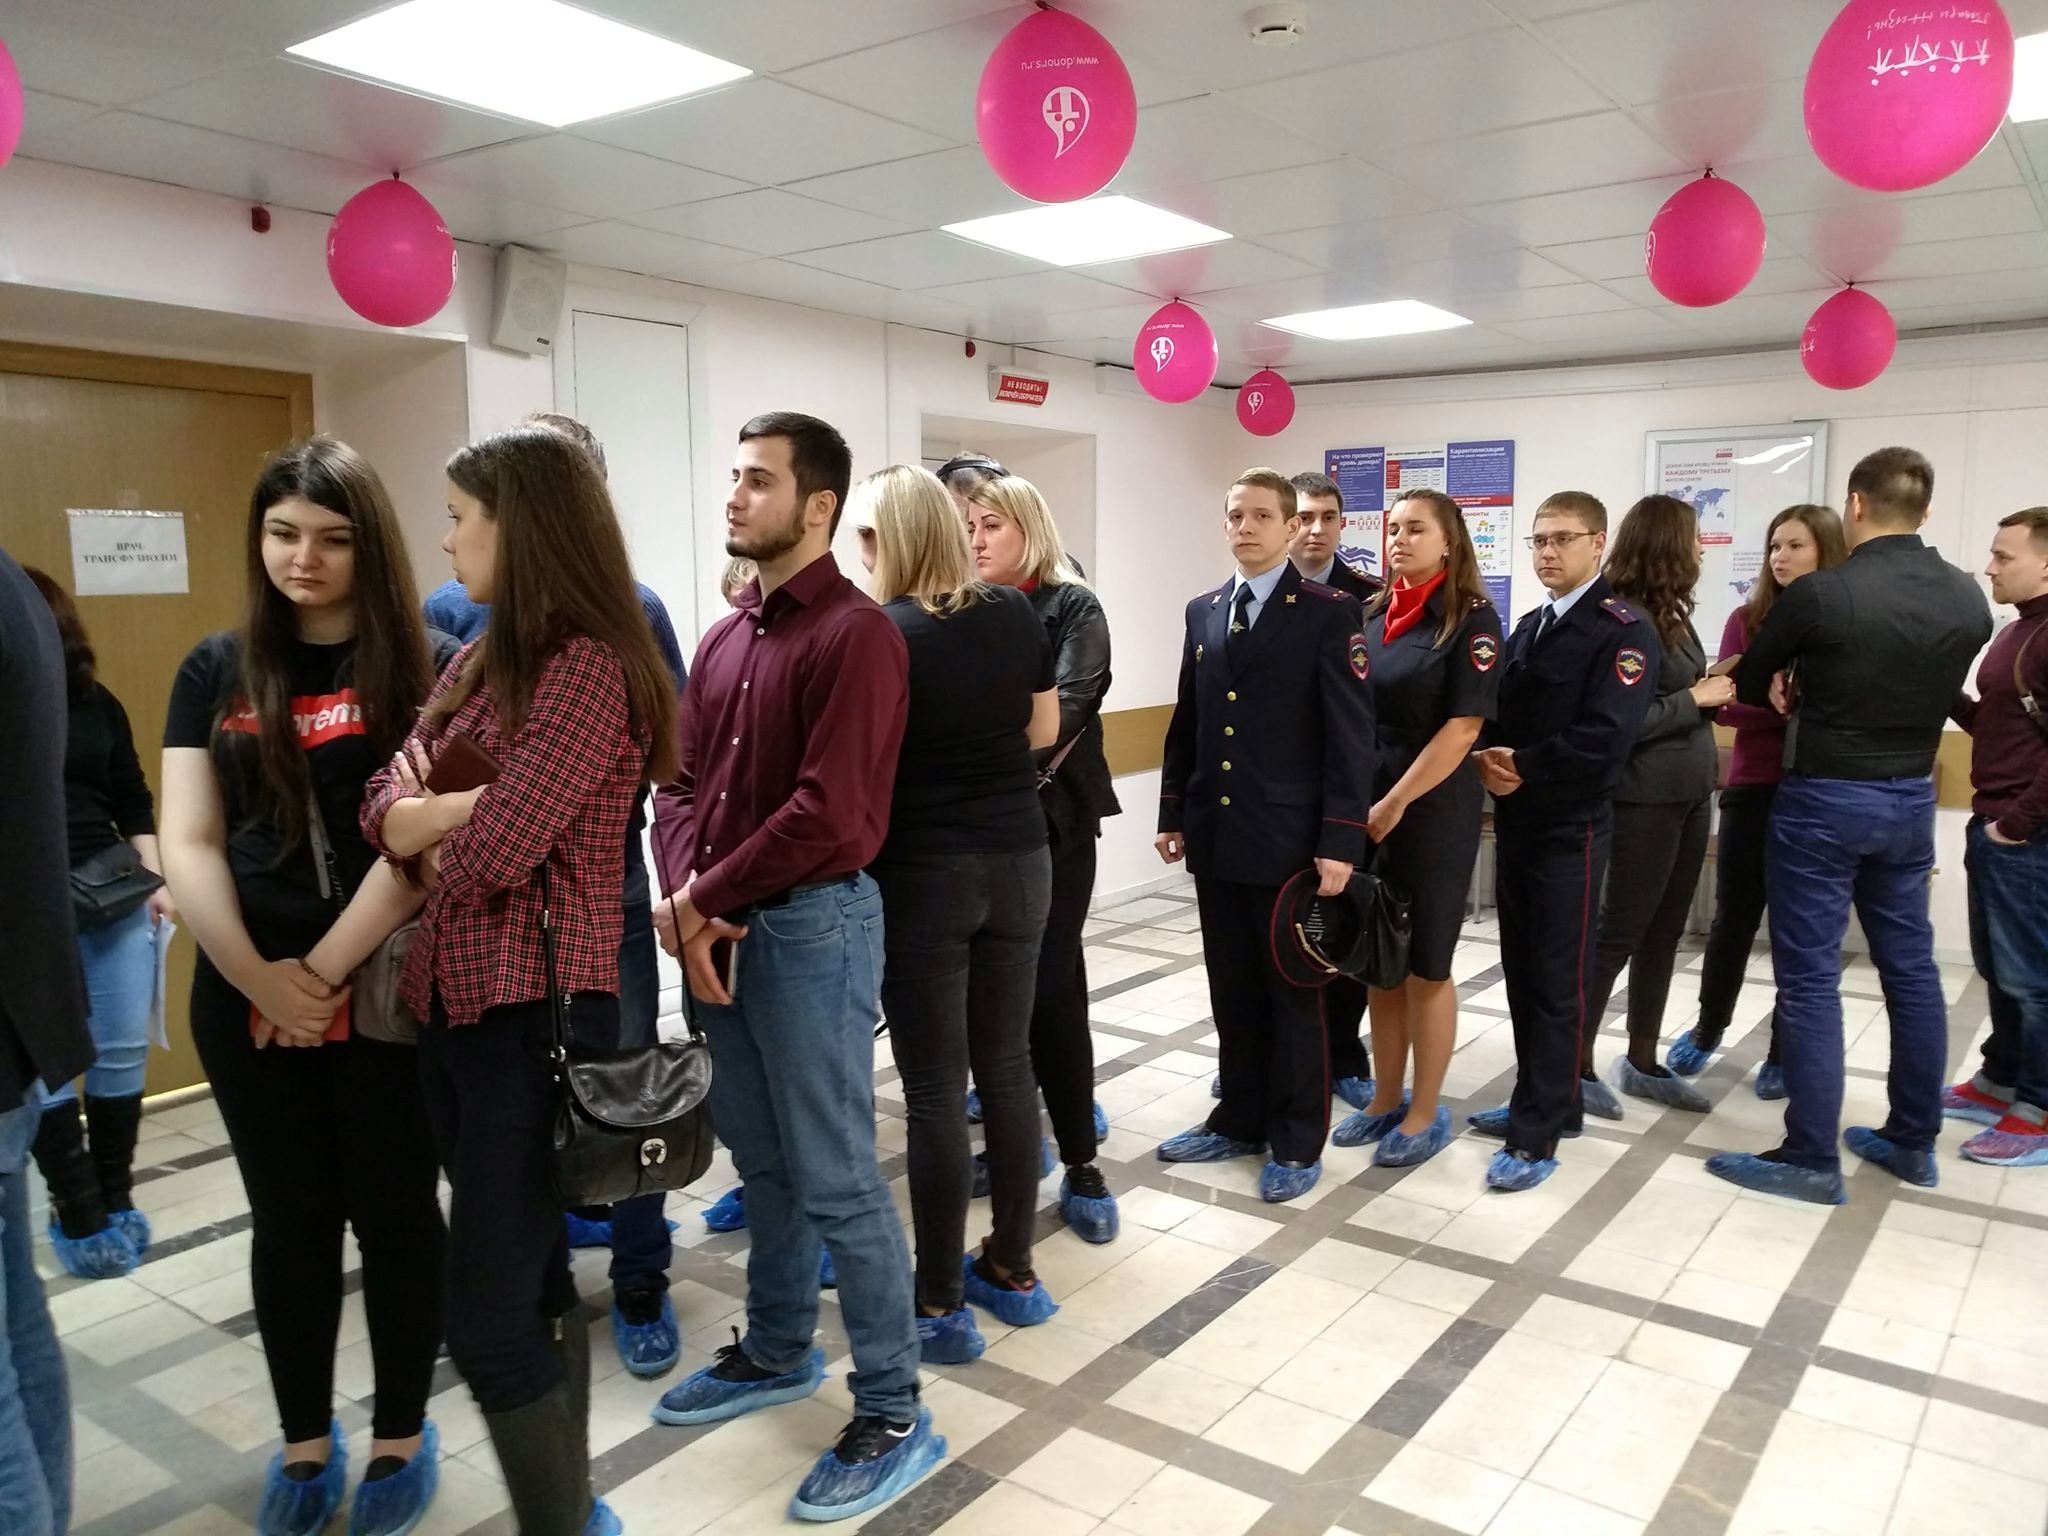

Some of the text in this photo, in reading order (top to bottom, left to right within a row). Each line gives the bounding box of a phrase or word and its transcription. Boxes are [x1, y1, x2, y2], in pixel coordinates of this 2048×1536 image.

[1021, 56, 1099, 70] www.donors.ru
[1351, 452, 1383, 460] проверяют
[1357, 458, 1382, 466] донора?
